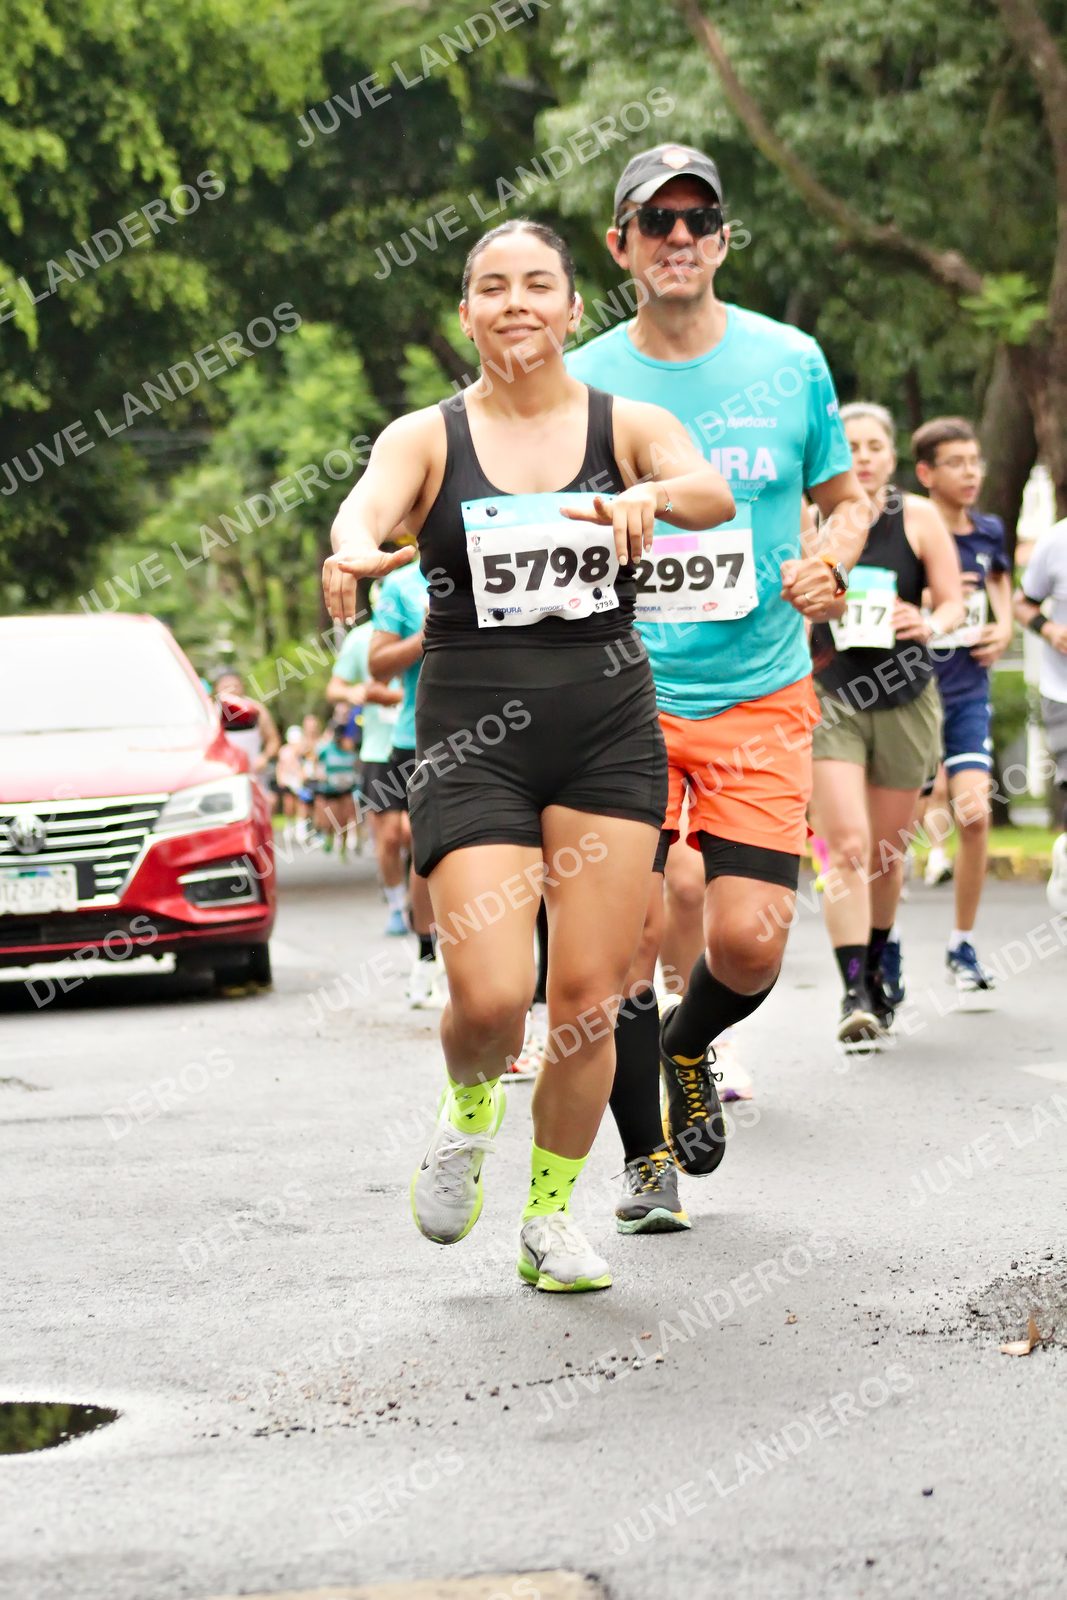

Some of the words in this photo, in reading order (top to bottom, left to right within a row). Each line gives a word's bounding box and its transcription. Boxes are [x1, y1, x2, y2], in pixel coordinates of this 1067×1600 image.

[483, 546, 611, 594] 5798
[633, 553, 745, 594] 2997
[595, 599, 614, 610] 5798
